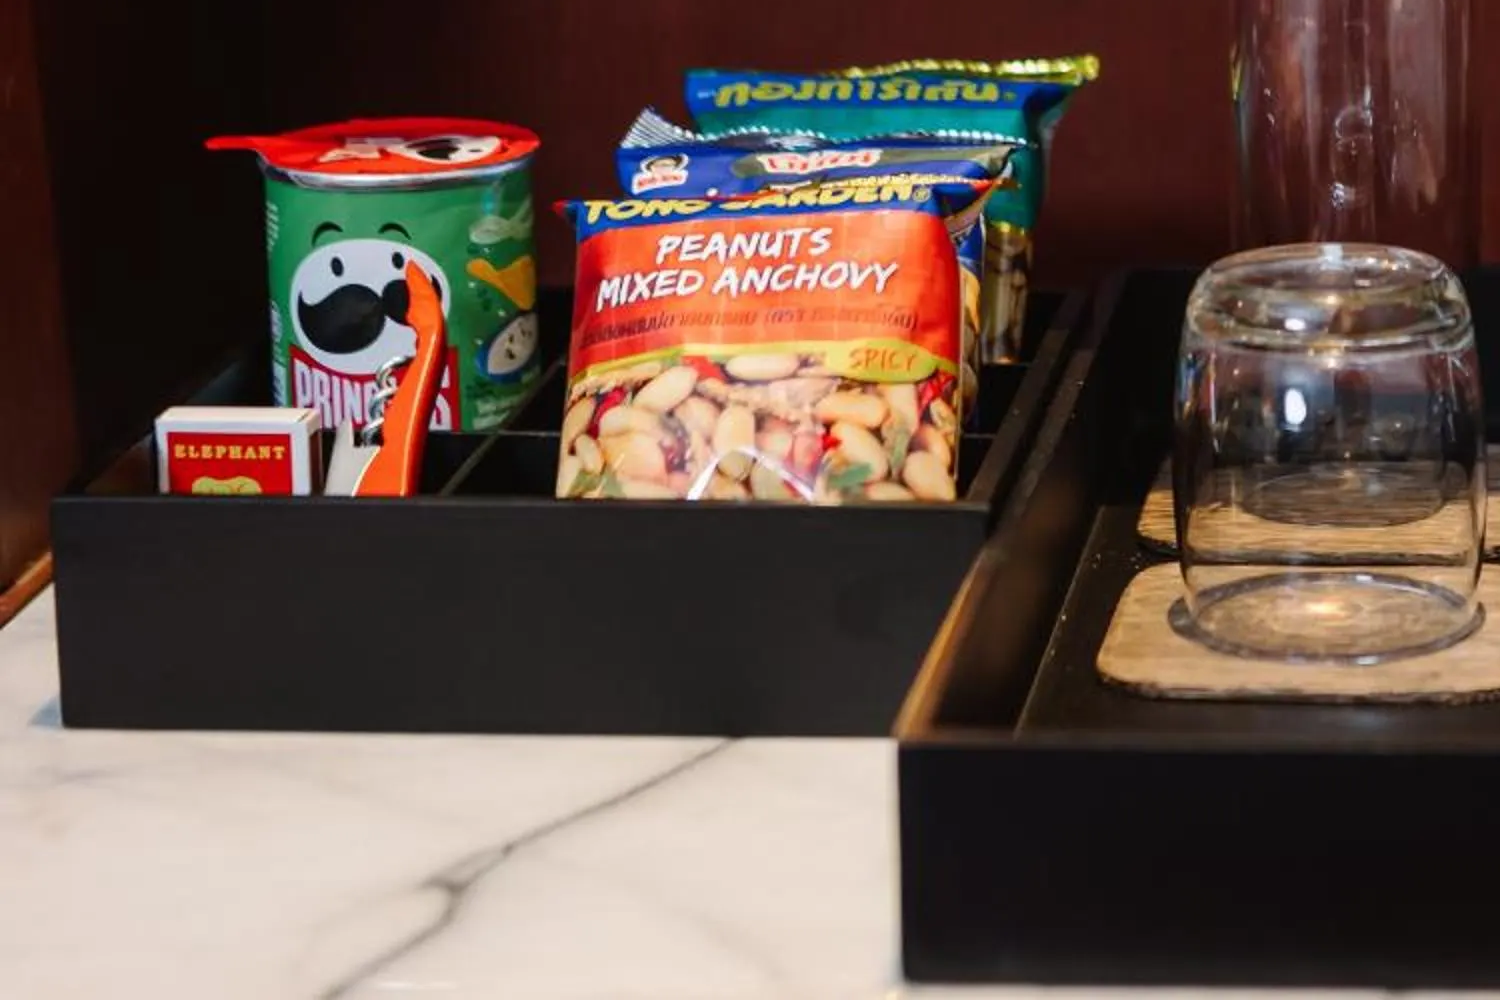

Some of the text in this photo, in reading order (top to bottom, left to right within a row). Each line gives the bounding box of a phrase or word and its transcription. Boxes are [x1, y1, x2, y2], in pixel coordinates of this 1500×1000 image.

[655, 227, 832, 264] PEANUTS
[594, 262, 898, 313] MIXED ANCHOVY
[848, 346, 917, 372] SPICY
[174, 444, 286, 460] ELEPHANT
